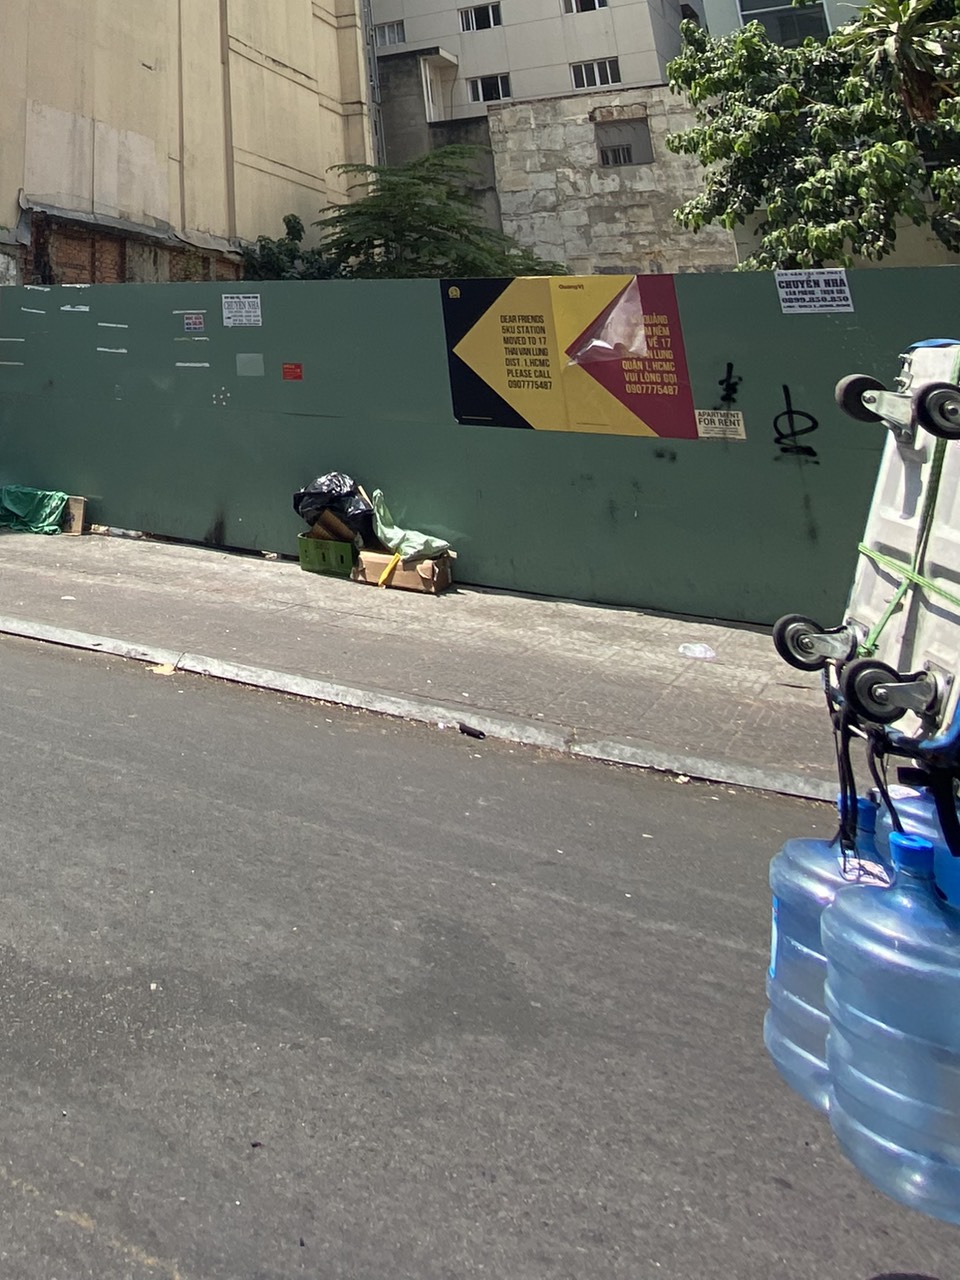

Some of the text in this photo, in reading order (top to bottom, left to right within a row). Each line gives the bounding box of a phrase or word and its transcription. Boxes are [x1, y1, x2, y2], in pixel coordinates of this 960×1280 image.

[500, 315, 544, 324] DEAR FRIENDS
[516, 326, 546, 335] STATION
[503, 336, 547, 345] MOVED TO 17
[661, 338, 671, 348] 17
[532, 348, 549, 356] LUNG
[654, 350, 674, 360] LUNG
[530, 359, 551, 368] HCMC
[652, 361, 676, 371] HCMC
[507, 369, 552, 379] PLEASE CALL
[624, 372, 639, 382] VUI
[640, 371, 661, 383] LÒNG
[508, 380, 553, 390] 0907775487
[626, 383, 679, 396] 0907775487
[697, 411, 740, 419] APARTMENT
[698, 417, 741, 428] FOR RENT
